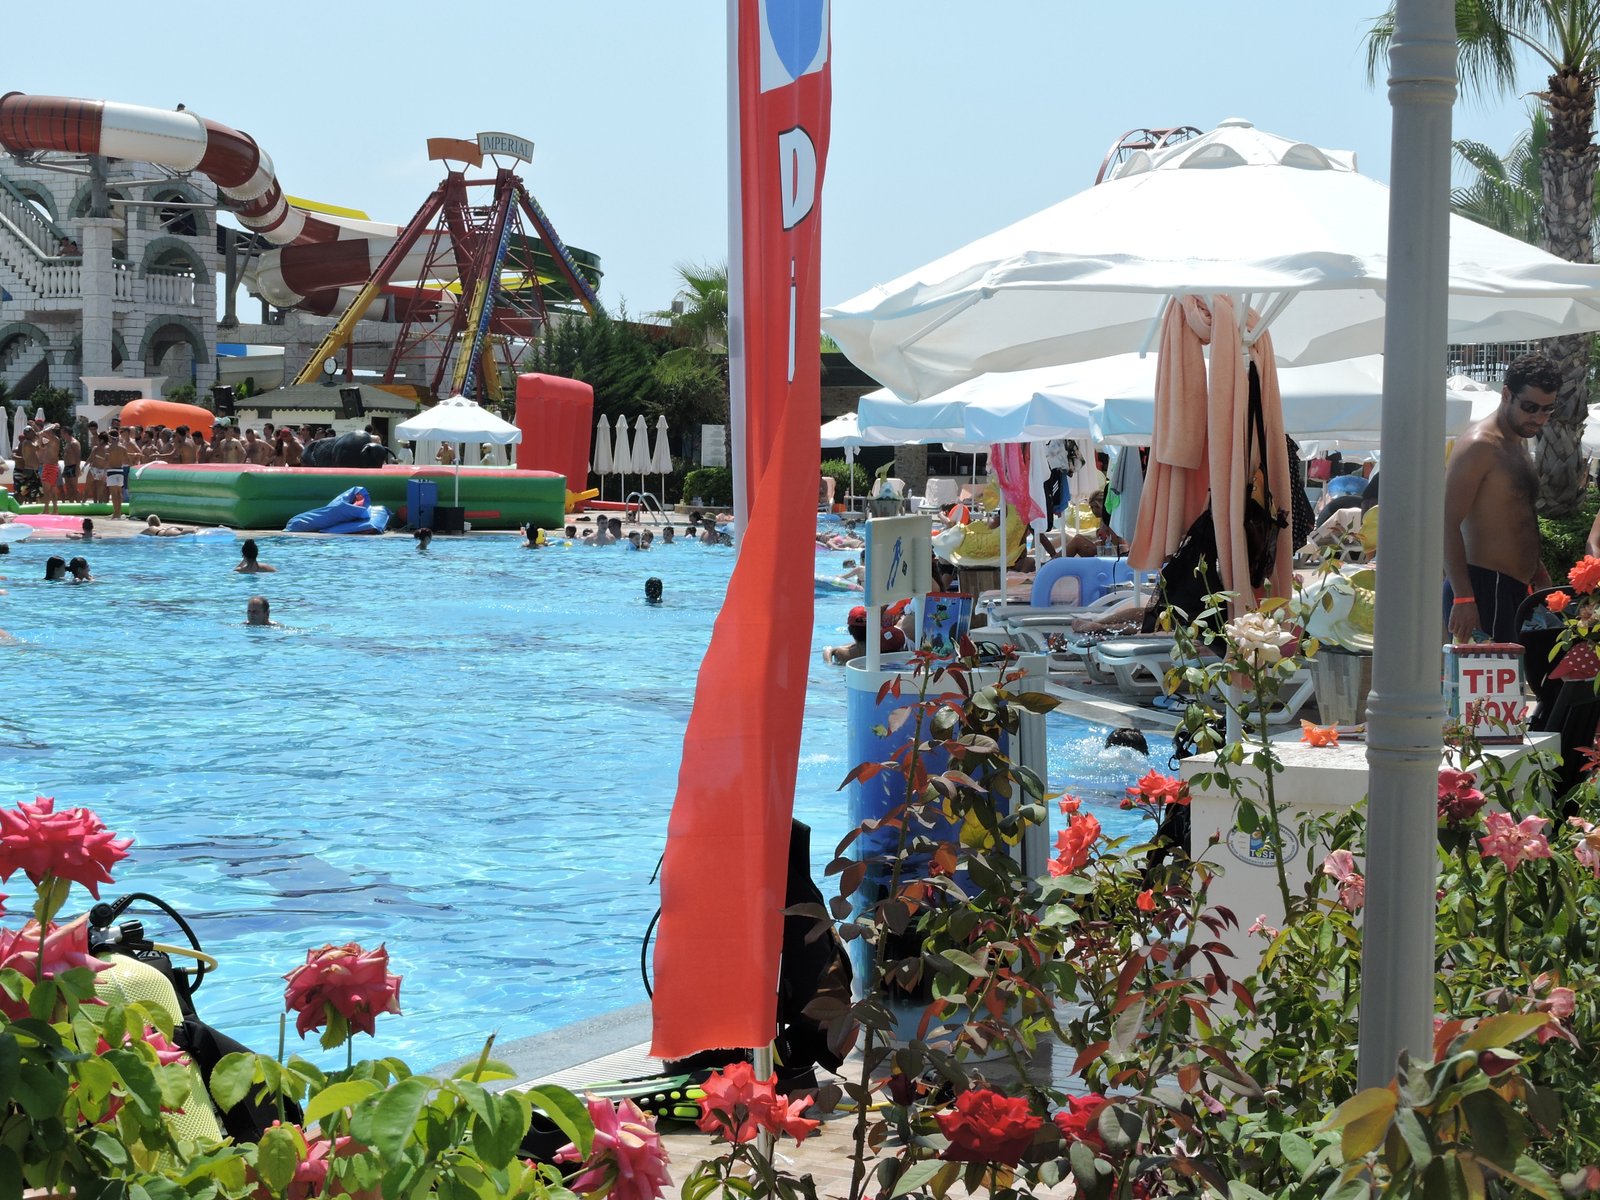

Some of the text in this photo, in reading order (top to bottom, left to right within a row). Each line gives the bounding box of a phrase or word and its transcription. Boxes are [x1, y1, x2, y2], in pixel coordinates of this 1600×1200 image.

[483, 136, 530, 158] IMPERIAL
[1463, 669, 1516, 694] TiP
[1250, 849, 1275, 860] TSF
